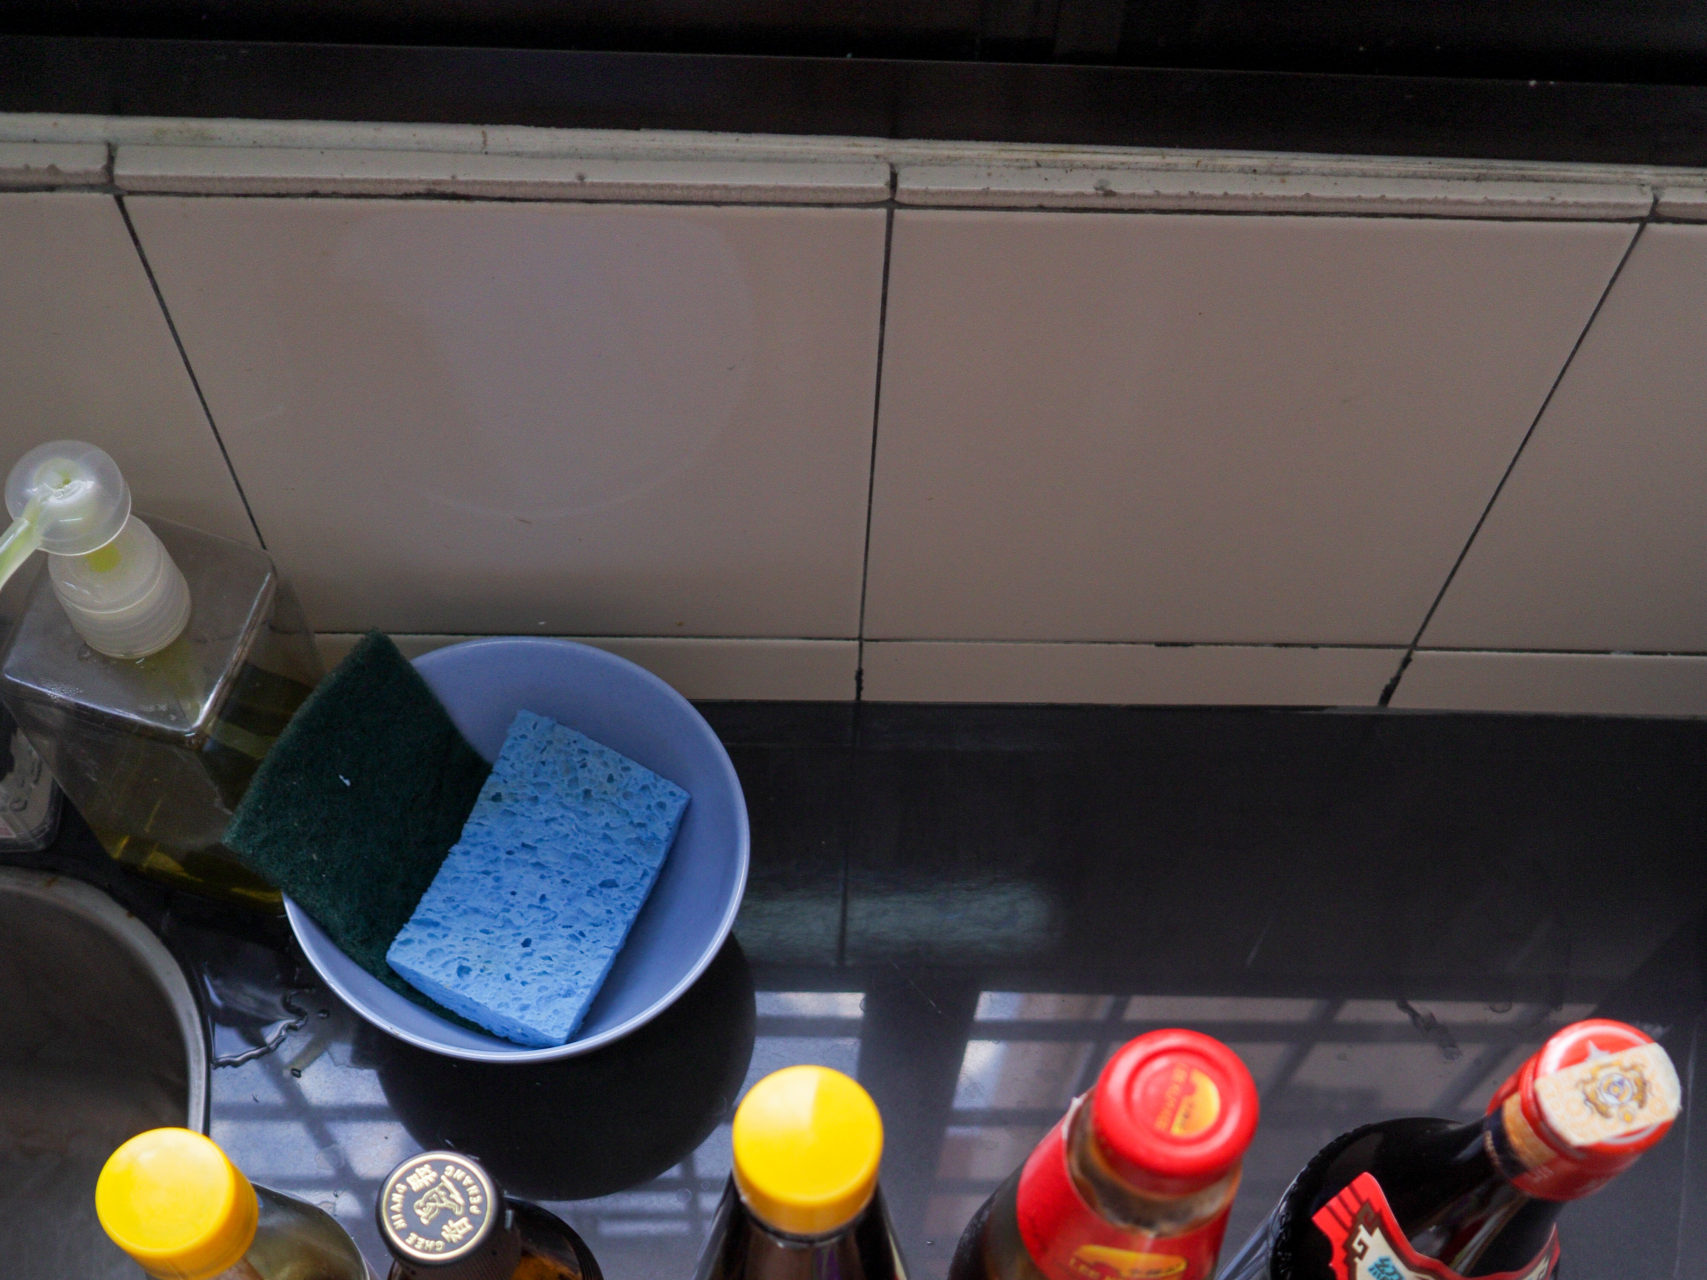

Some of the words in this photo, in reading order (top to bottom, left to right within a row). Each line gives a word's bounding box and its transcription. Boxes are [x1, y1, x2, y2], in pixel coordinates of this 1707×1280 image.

[390, 1183, 408, 1230] HIANG
[444, 1165, 482, 1215] PENANG
[405, 1232, 445, 1251] GHEE
